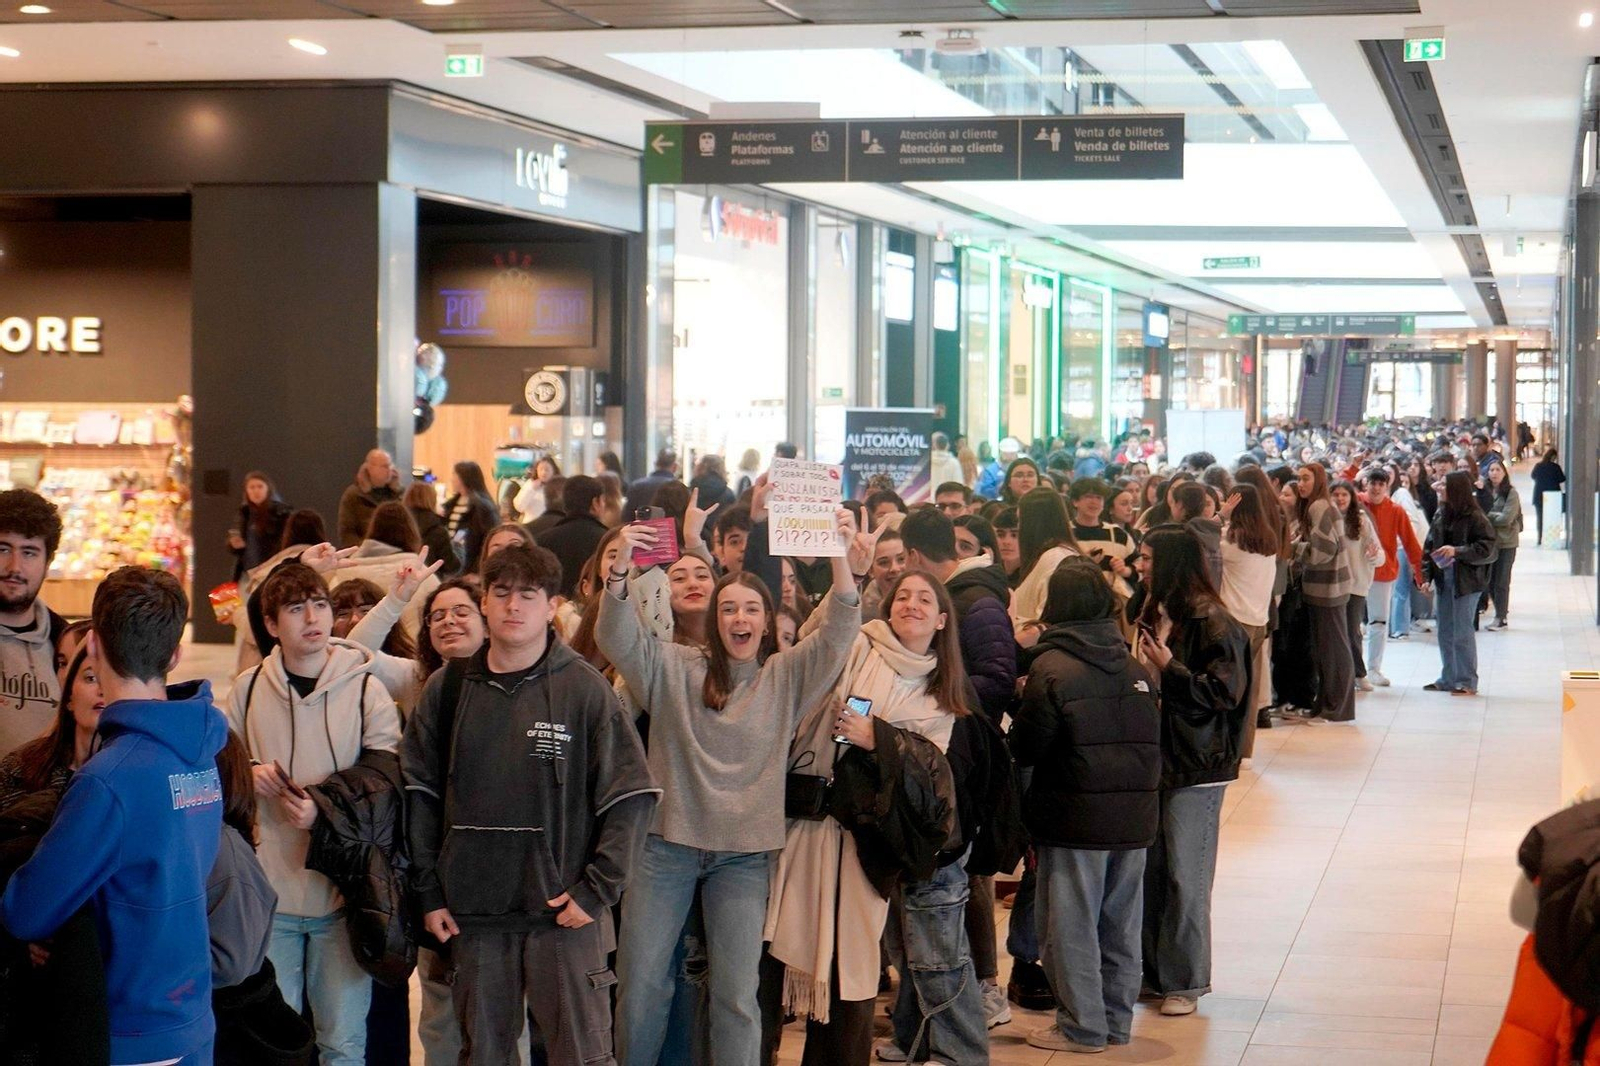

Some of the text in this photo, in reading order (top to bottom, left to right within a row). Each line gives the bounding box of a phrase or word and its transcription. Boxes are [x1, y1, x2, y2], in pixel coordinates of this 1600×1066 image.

[731, 131, 776, 142] Andenes
[900, 128, 998, 140] Atención al cliente
[1074, 126, 1164, 137] Venta de billetes
[731, 144, 794, 155] Plataformas
[900, 142, 1004, 153] Atención ao cliente
[1074, 141, 1170, 151] Venda de billetes
[899, 156, 965, 164] CUSTOMER SERVICE
[445, 296, 486, 328] POP
[846, 432, 929, 449] AUTOMÓVIL
[861, 447, 920, 457] MOTOCICLETA
[774, 503, 795, 514] QUE
[526, 729, 538, 738] OF
